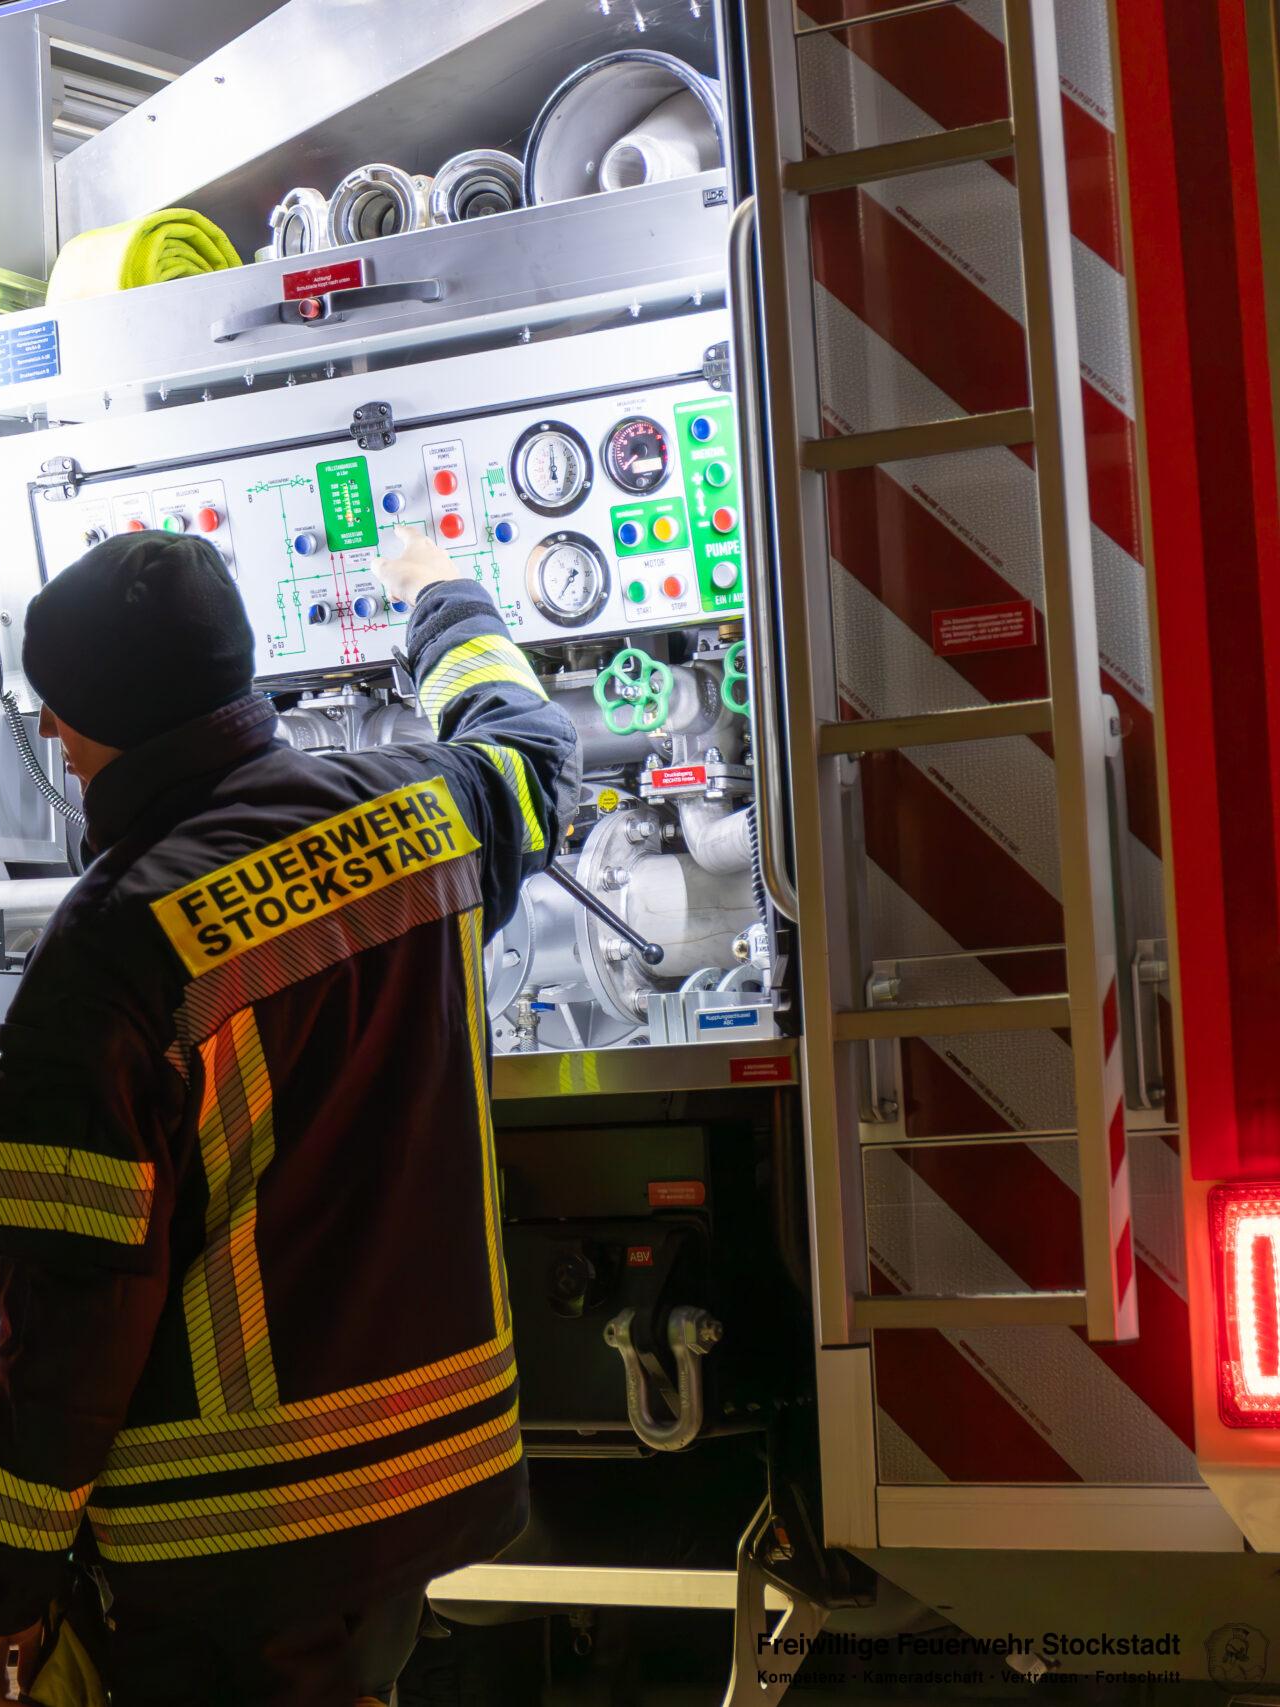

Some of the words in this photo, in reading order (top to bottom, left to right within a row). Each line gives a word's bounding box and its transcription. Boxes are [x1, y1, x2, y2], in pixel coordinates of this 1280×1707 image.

[705, 540, 741, 558] PUMPE
[644, 559, 666, 568] MOTOR
[715, 595, 727, 605] EIN
[176, 791, 448, 927] FEUERWEHR
[196, 822, 457, 957] STOCKSTADT
[630, 1251, 649, 1261] ABV
